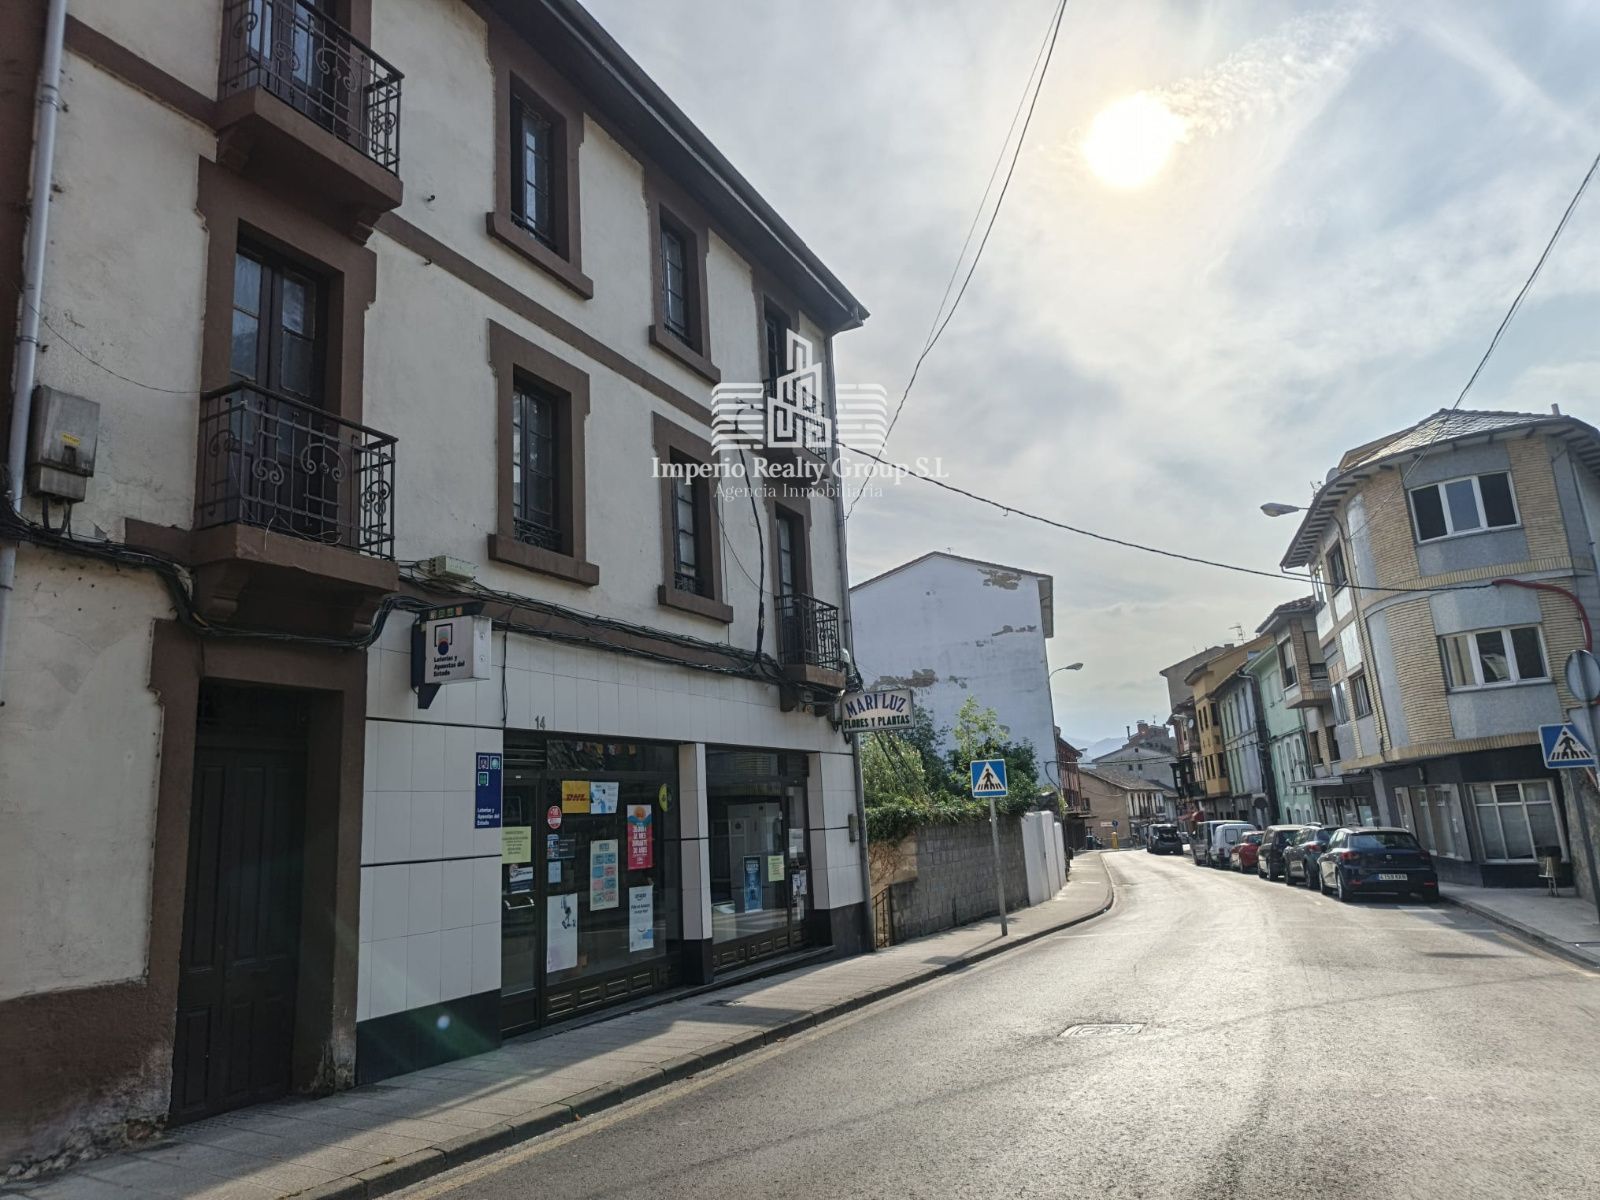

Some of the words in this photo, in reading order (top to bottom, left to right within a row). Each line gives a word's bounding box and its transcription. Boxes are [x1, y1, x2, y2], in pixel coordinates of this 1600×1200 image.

[535, 715, 546, 730] 14
[844, 717, 869, 729] FLORES
[871, 717, 876, 727] Y
[878, 714, 910, 726] PLANTAS
